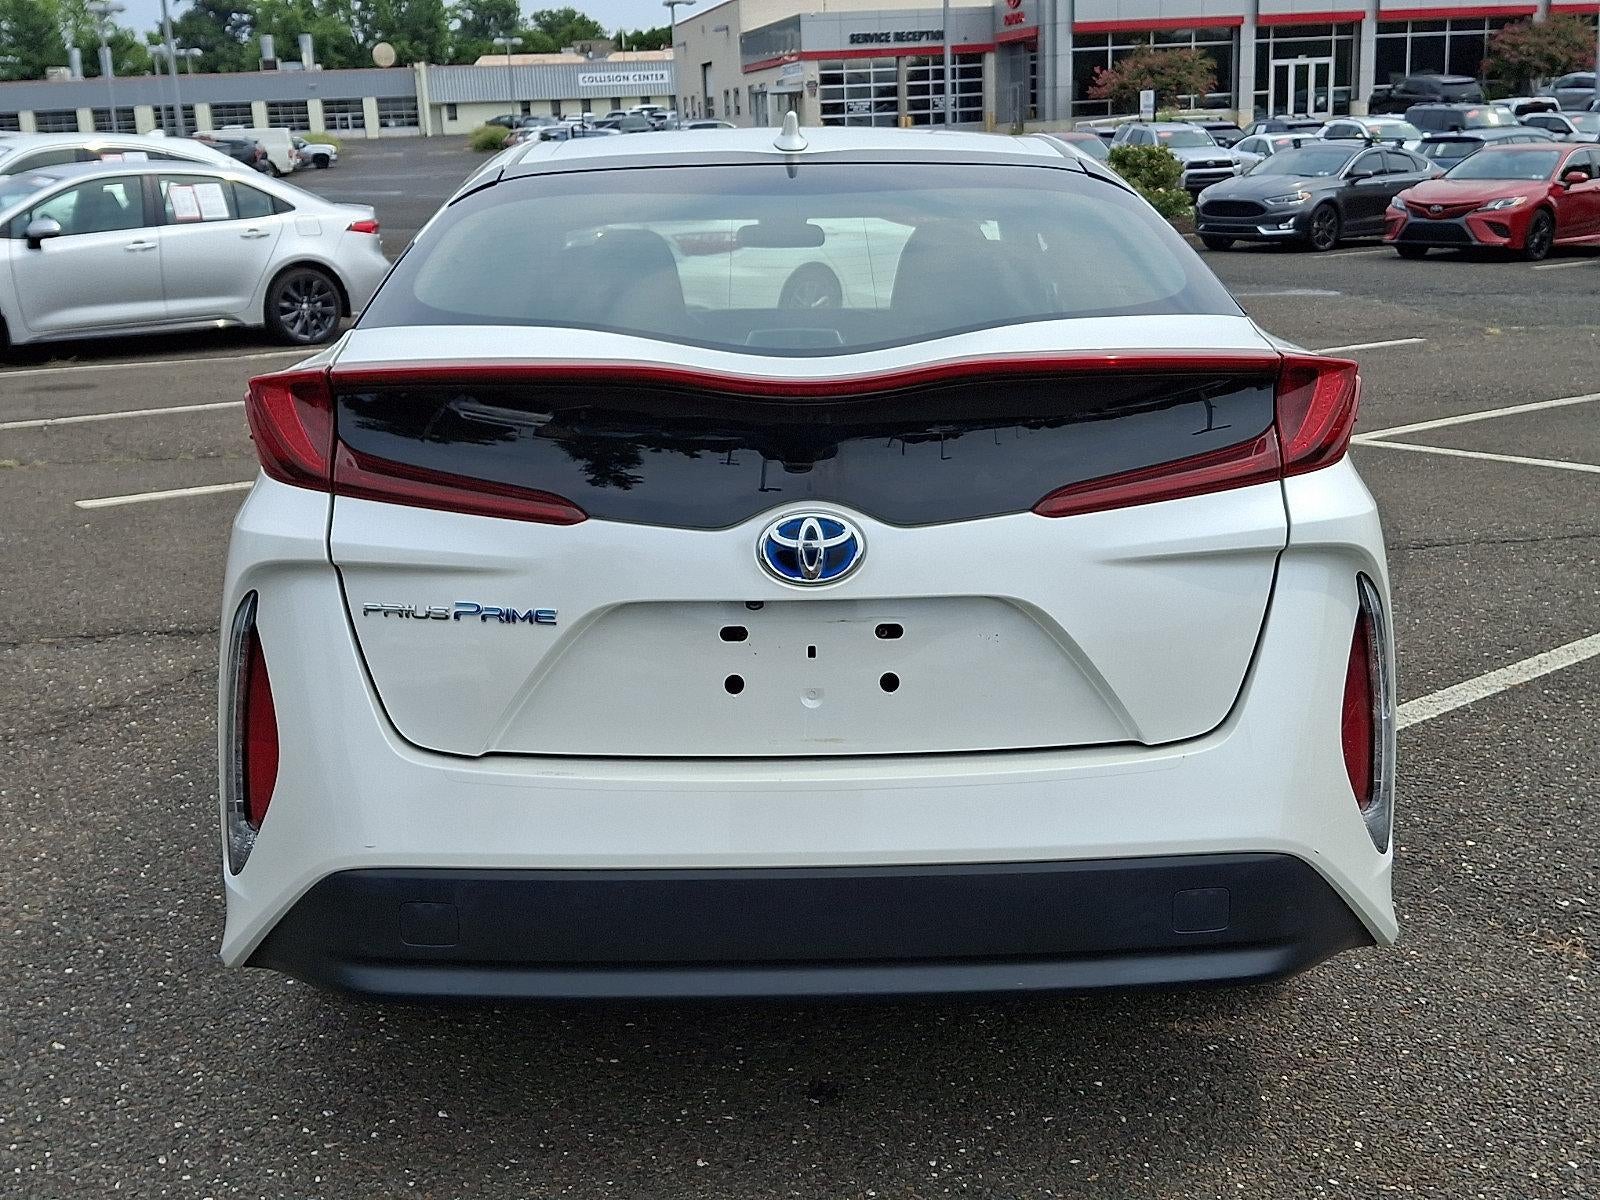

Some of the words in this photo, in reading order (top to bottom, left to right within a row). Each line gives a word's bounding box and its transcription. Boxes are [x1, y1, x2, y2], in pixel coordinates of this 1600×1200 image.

[849, 32, 891, 44] SERVICE
[581, 75, 629, 84] COLLISION
[632, 73, 664, 82] CENTER
[363, 602, 450, 620] PRIUS
[453, 600, 558, 626] PRIME
